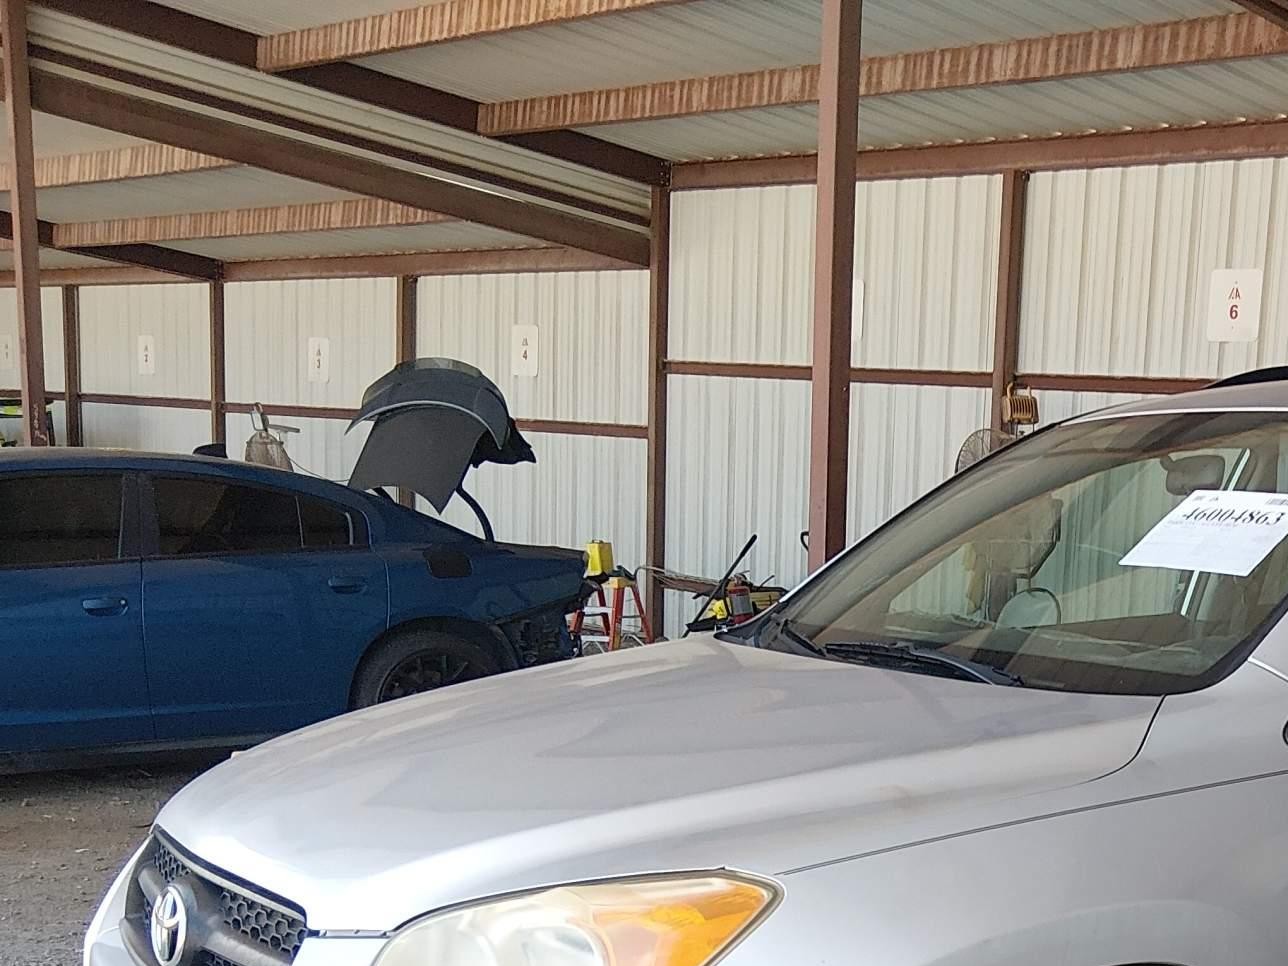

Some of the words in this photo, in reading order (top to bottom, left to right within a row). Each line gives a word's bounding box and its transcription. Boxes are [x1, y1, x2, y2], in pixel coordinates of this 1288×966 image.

[1229, 304, 1239, 320] 6
[522, 350, 528, 361] 4
[1182, 507, 1286, 526] 46004863
